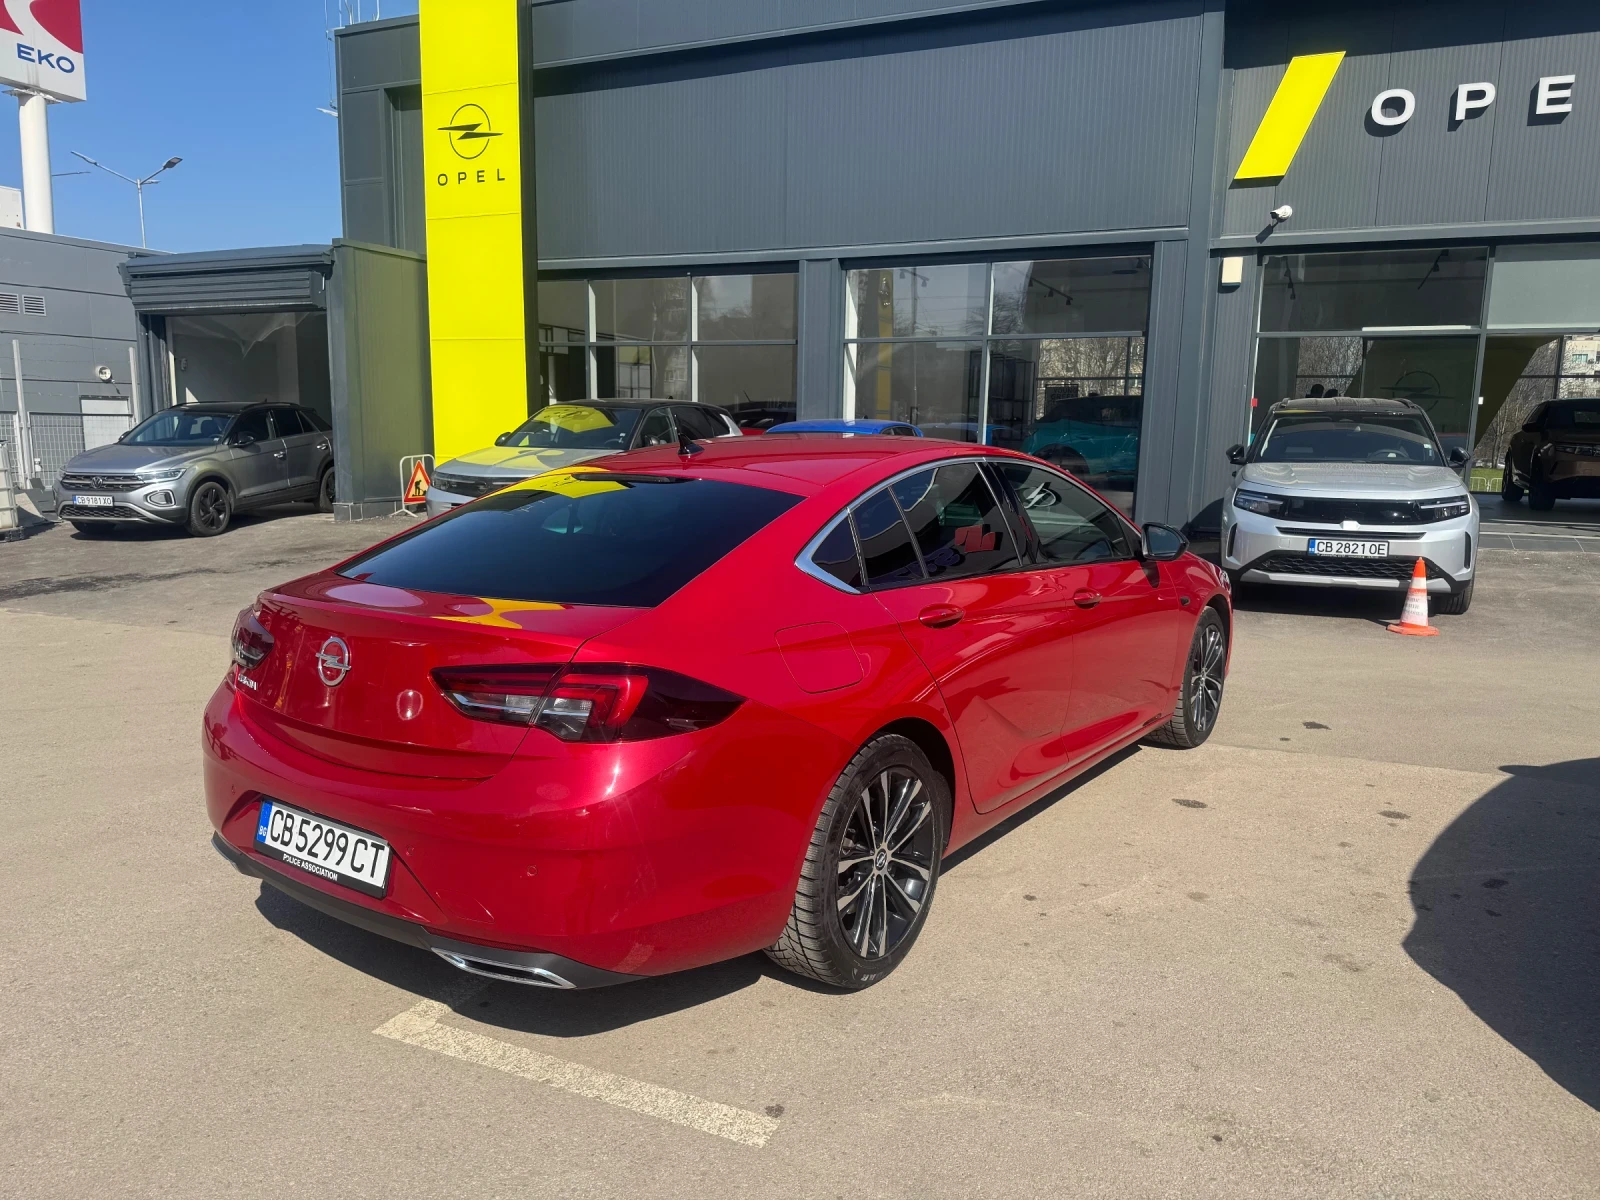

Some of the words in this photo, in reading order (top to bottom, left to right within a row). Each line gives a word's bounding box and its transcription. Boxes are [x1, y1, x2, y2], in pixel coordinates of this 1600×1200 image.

[17, 43, 75, 73] EKO
[1371, 74, 1576, 126] OPE
[437, 168, 506, 186] OPEL
[1316, 541, 1333, 553] CB
[1335, 542, 1366, 554] 2821
[1368, 543, 1386, 556] OE
[258, 825, 268, 837] BG
[270, 809, 295, 847] CB
[295, 818, 349, 867] 5299
[350, 838, 385, 878] CT
[282, 853, 301, 867] POLICE
[300, 860, 338, 881] ASSOCIATION
